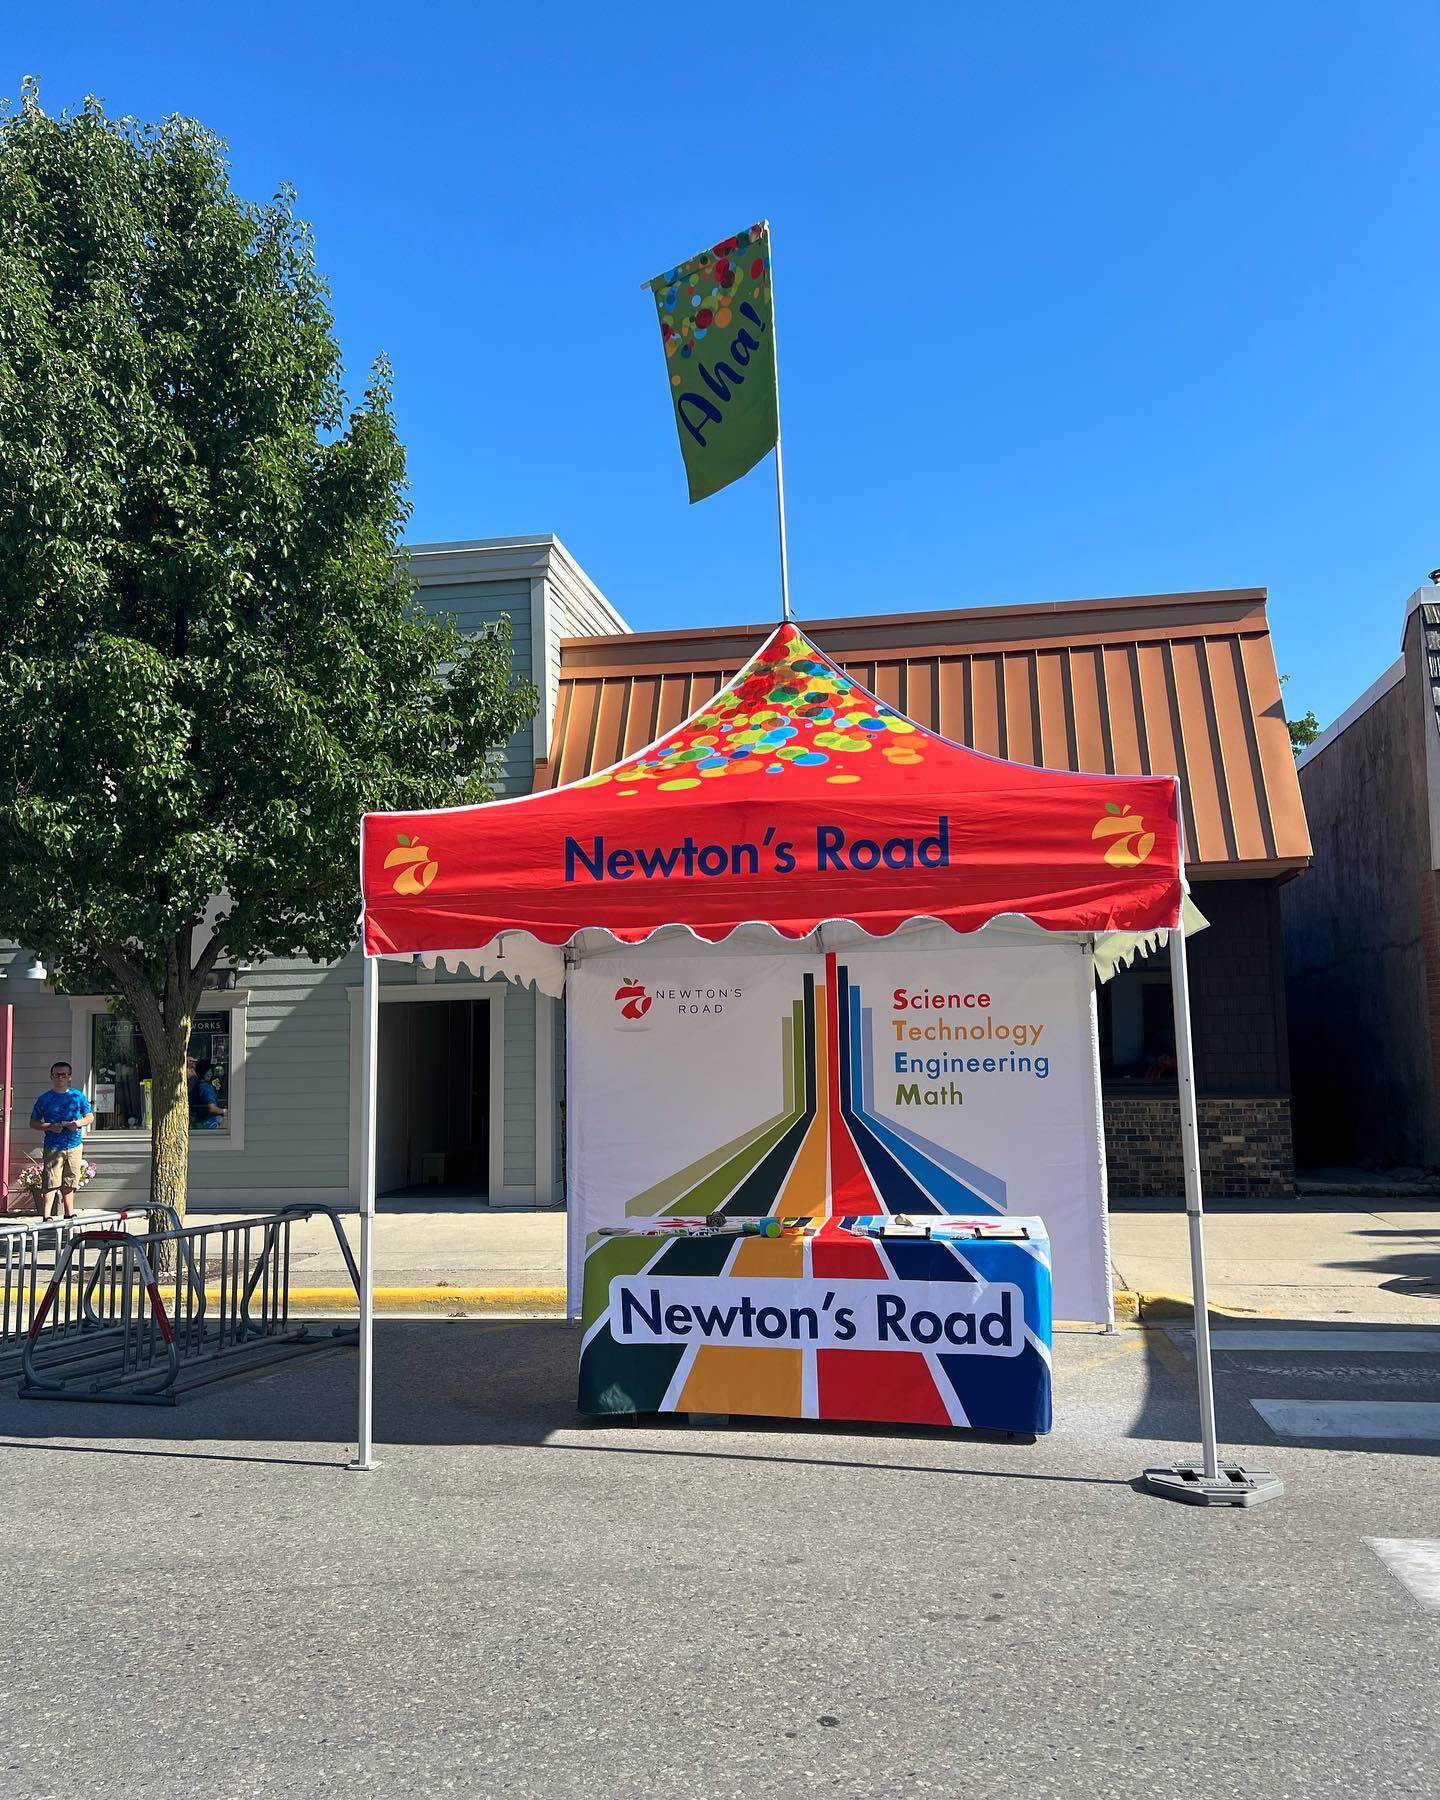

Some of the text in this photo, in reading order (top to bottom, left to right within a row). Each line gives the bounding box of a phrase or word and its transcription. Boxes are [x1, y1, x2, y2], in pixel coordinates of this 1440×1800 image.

[677, 301, 766, 447] Aha!
[565, 815, 950, 882] Newton's Road
[656, 988, 742, 999] NEWTON'S
[893, 988, 991, 1010] Science
[678, 1004, 723, 1014] ROAD
[892, 1016, 1044, 1046] Technology
[895, 1051, 1049, 1079] Engineering
[895, 1082, 963, 1105] Math
[621, 1287, 1012, 1347] Newton's Road
